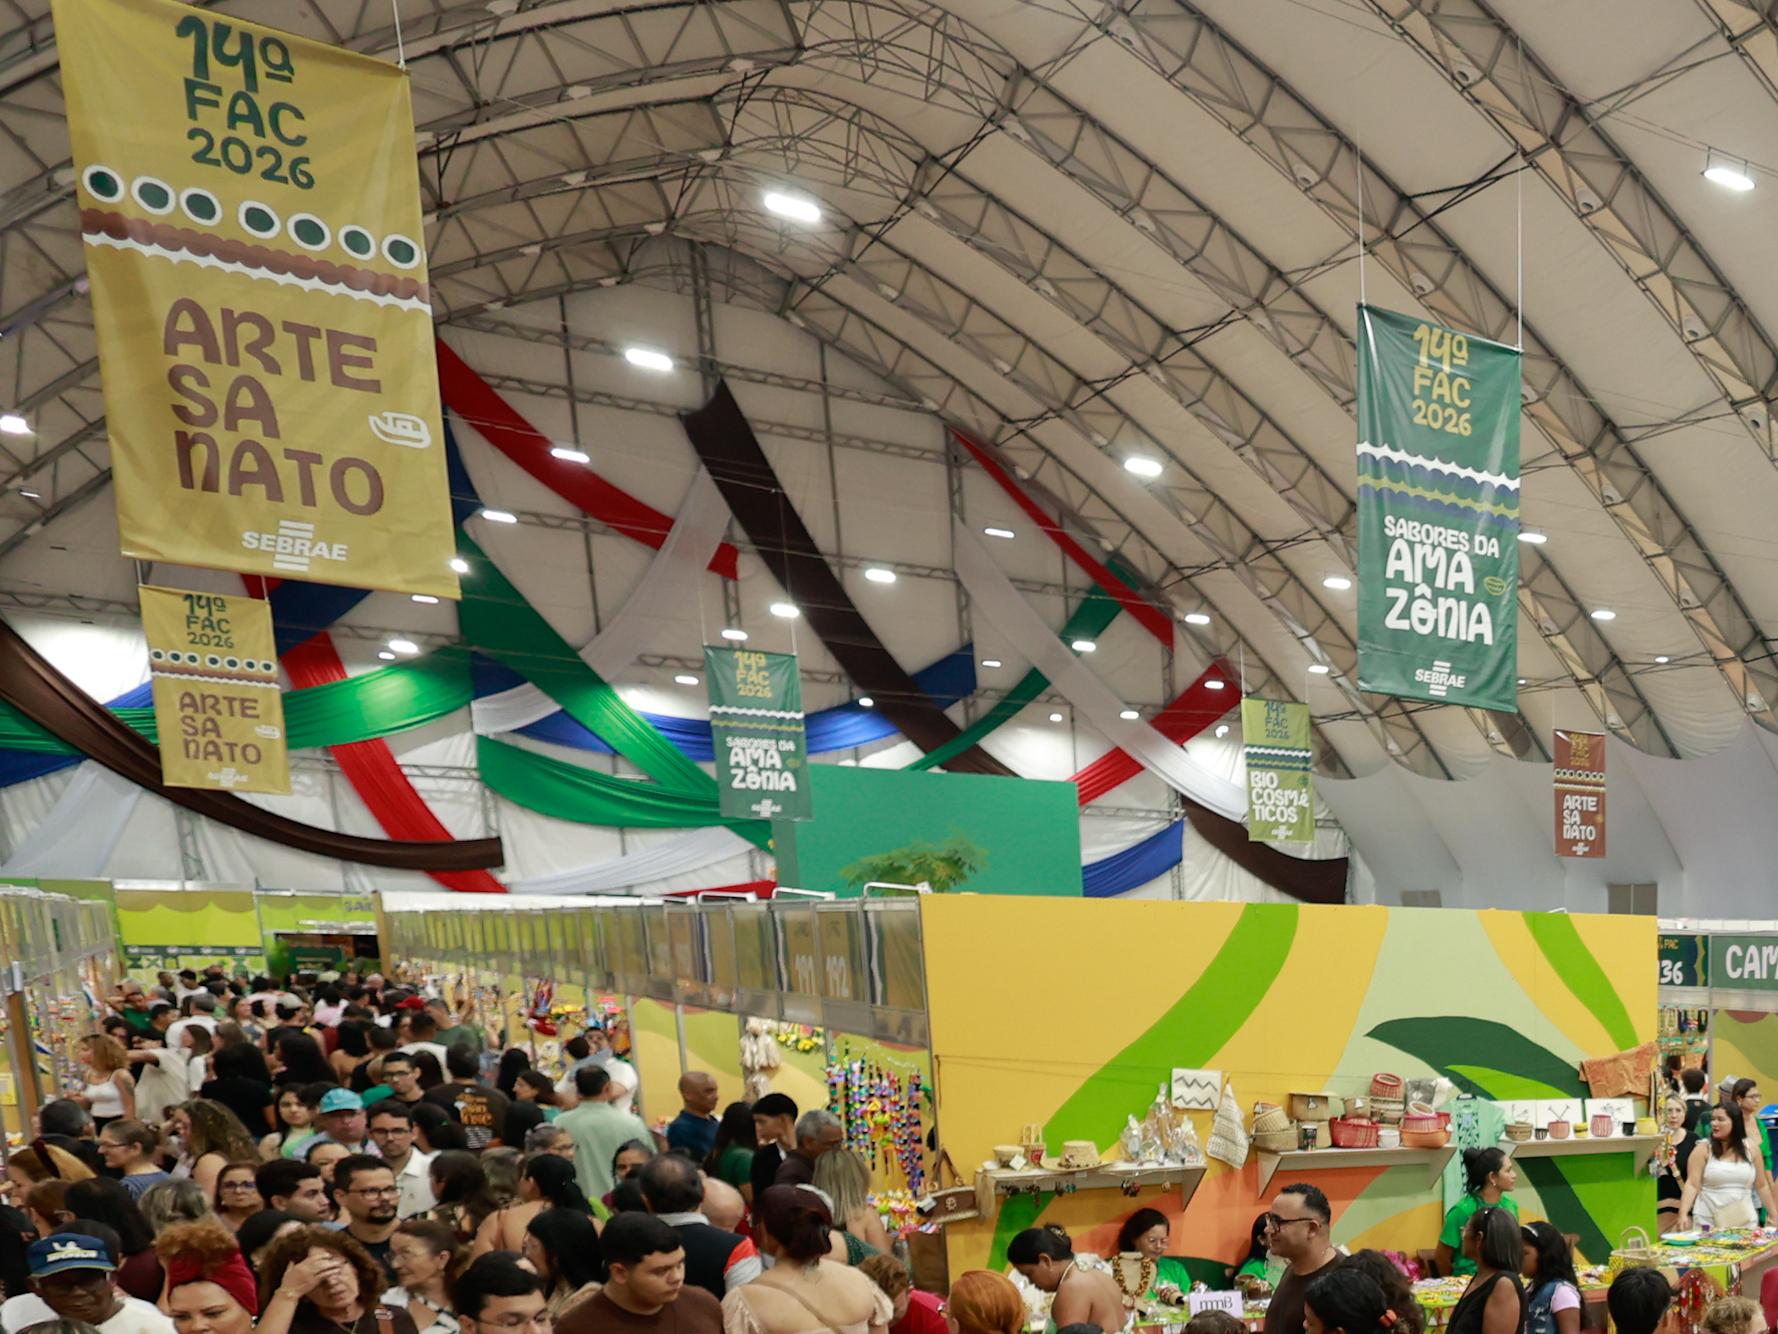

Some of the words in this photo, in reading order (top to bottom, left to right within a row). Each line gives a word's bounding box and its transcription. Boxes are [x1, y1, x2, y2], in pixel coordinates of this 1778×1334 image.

[184, 77, 307, 147] FAC
[187, 127, 315, 190] 2026
[164, 297, 382, 393] ARTE
[1413, 366, 1471, 408] FAC
[168, 364, 281, 438] SA
[1412, 399, 1472, 436] 2026
[175, 430, 384, 516] NATO
[242, 531, 348, 561] SEBRAE
[1384, 515, 1469, 553] SABORES
[1474, 534, 1500, 558] DA
[1385, 538, 1475, 594] AMA
[186, 616, 231, 633] FAC
[1384, 583, 1493, 646] ZÔNIA
[187, 632, 235, 649] 2026
[736, 670, 770, 685] FAC
[1414, 669, 1466, 688] SEBRAE
[737, 685, 772, 699] 2026
[179, 692, 260, 719] ARTE
[182, 715, 222, 738] SA
[1265, 717, 1288, 729] FAC
[183, 739, 261, 764] NATO
[726, 737, 777, 750] SABORES
[729, 747, 782, 769] AMA
[731, 767, 797, 792] ZÔNIA
[1250, 771, 1278, 789] BIO
[1253, 805, 1298, 823] TICOS
[1563, 795, 1597, 811] ARTE
[1563, 810, 1580, 824] SA
[1657, 960, 1683, 984] 36
